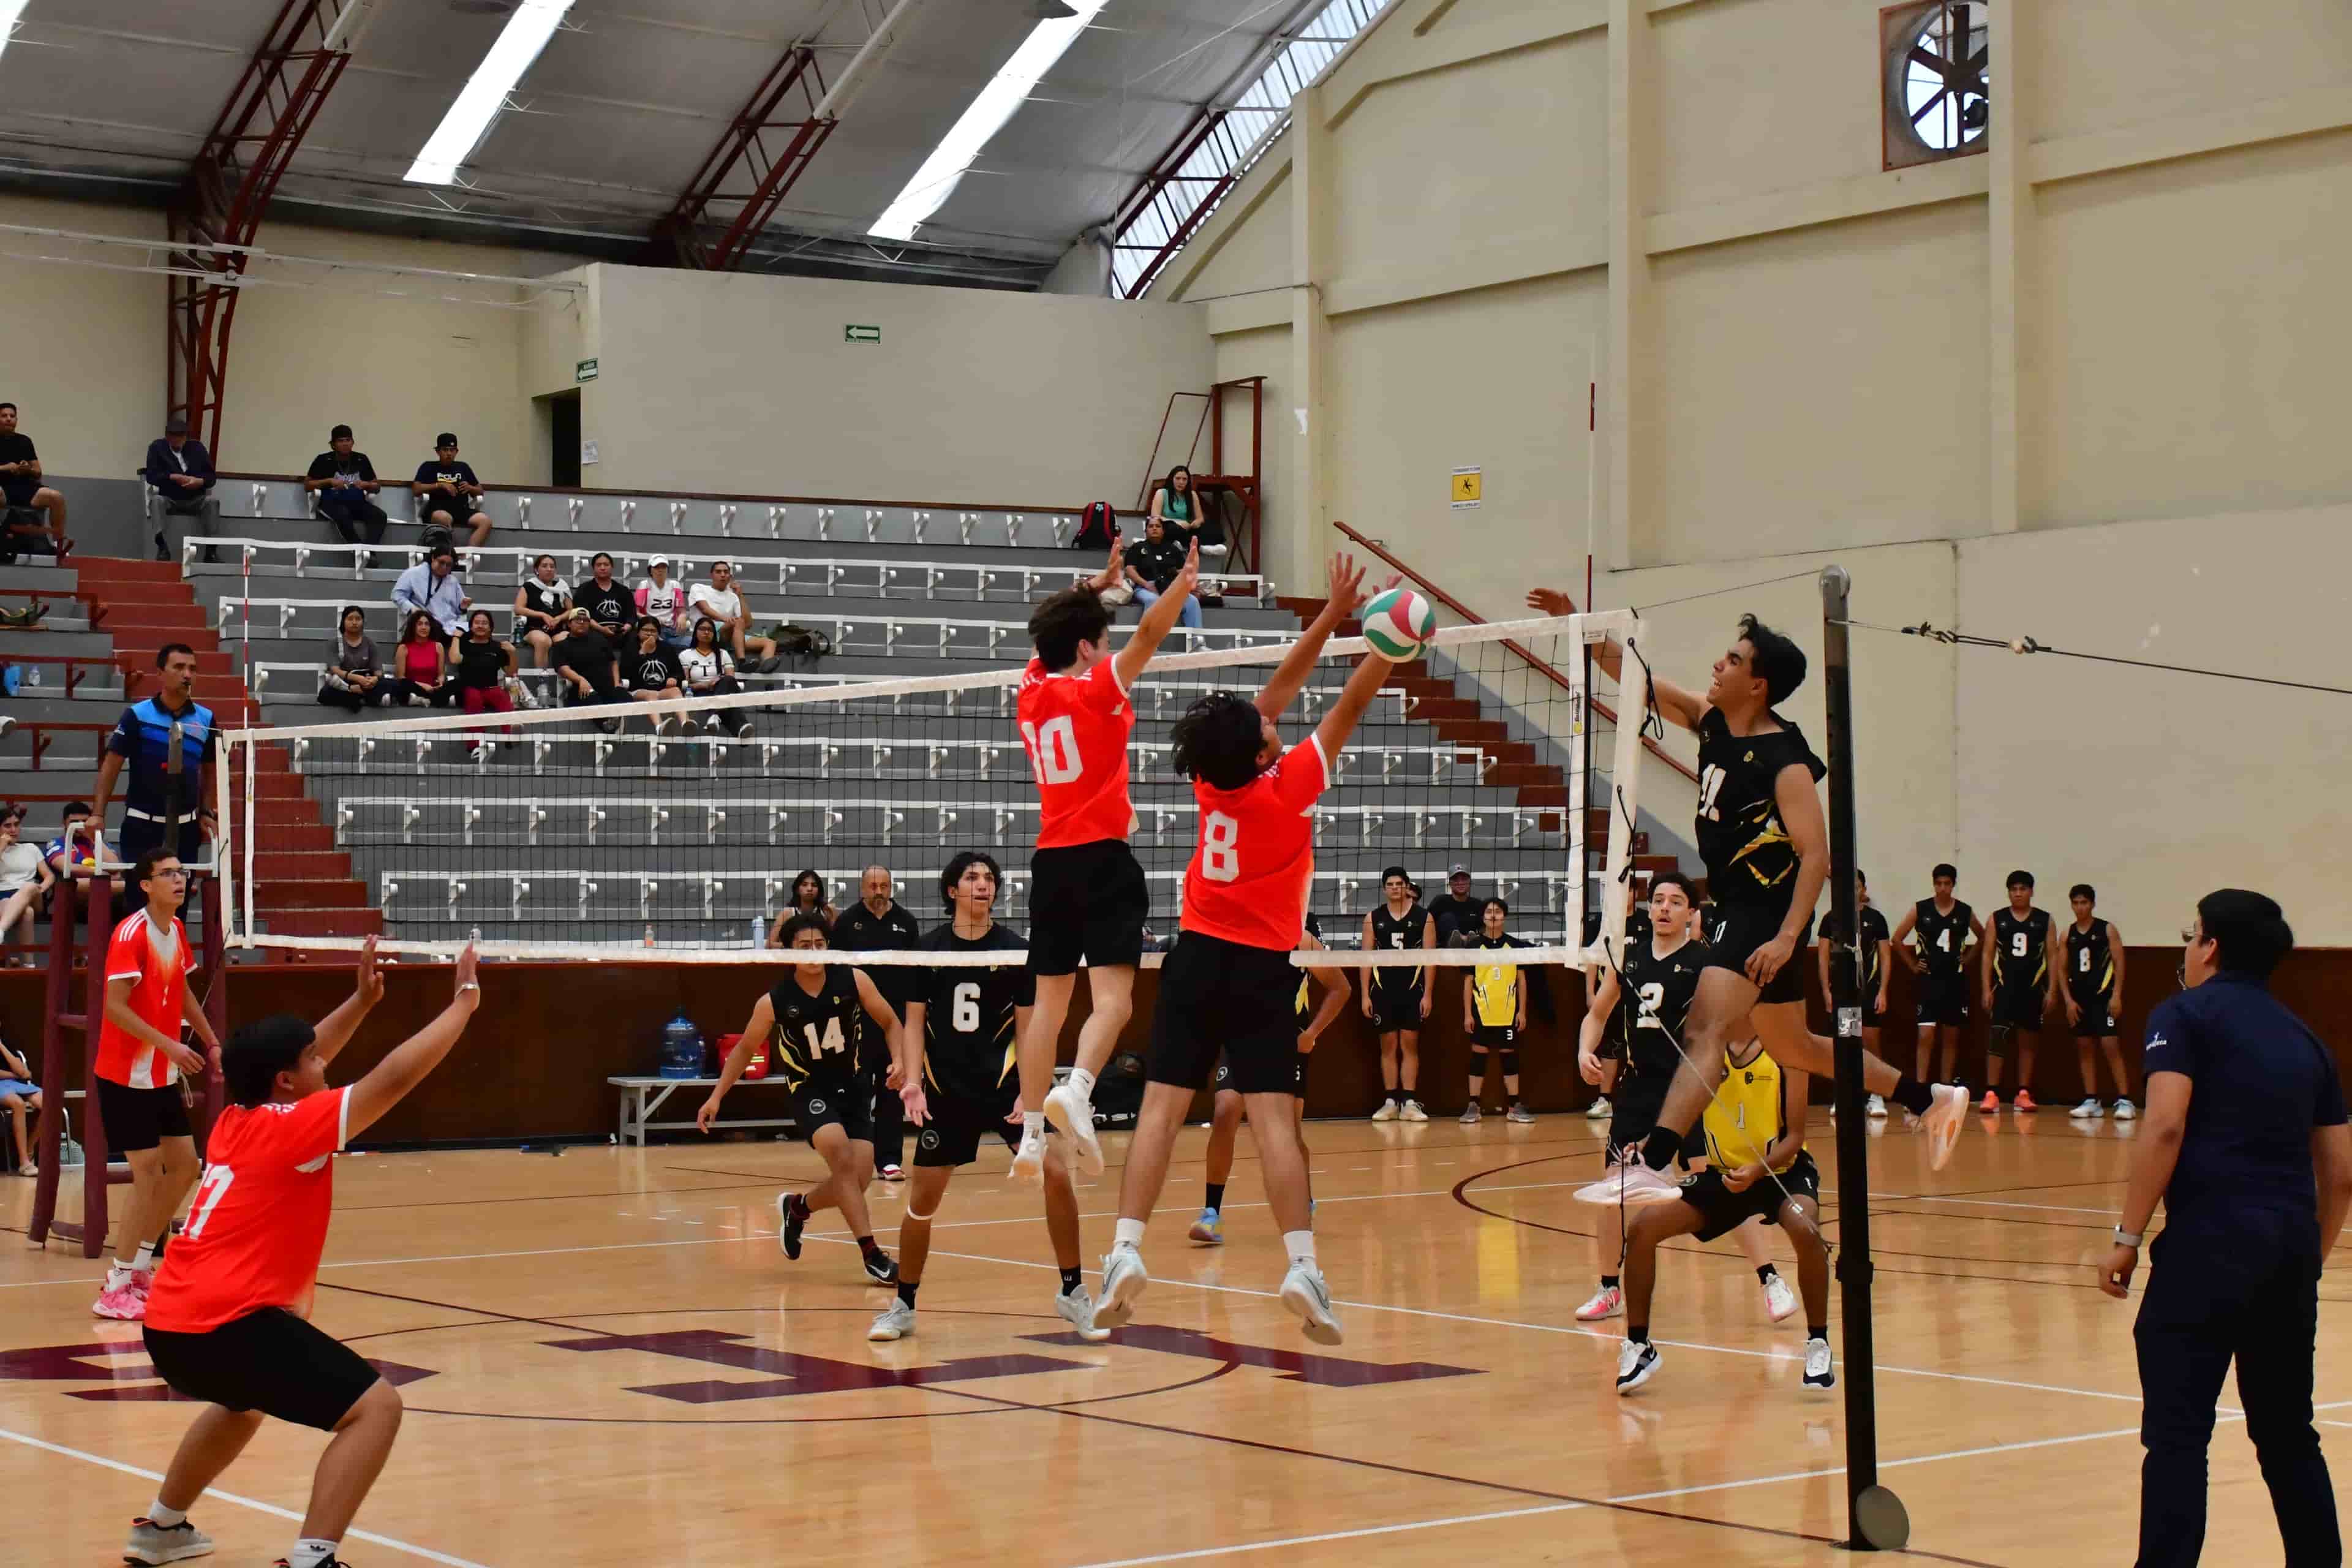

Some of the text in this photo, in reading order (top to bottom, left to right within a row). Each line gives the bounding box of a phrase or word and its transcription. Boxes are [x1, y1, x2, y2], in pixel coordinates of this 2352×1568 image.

[651, 598, 673, 609] 23
[1021, 715, 1084, 784] 10
[1202, 810, 1240, 882] 8
[1936, 929, 1950, 952] 4
[2011, 932, 2027, 957] 9
[2079, 946, 2090, 971] 8
[952, 982, 980, 1032] 6
[1637, 982, 1664, 1028] 2
[804, 1016, 845, 1060] 14
[1507, 1030, 1513, 1039] 3
[1736, 1102, 1745, 1129] 1
